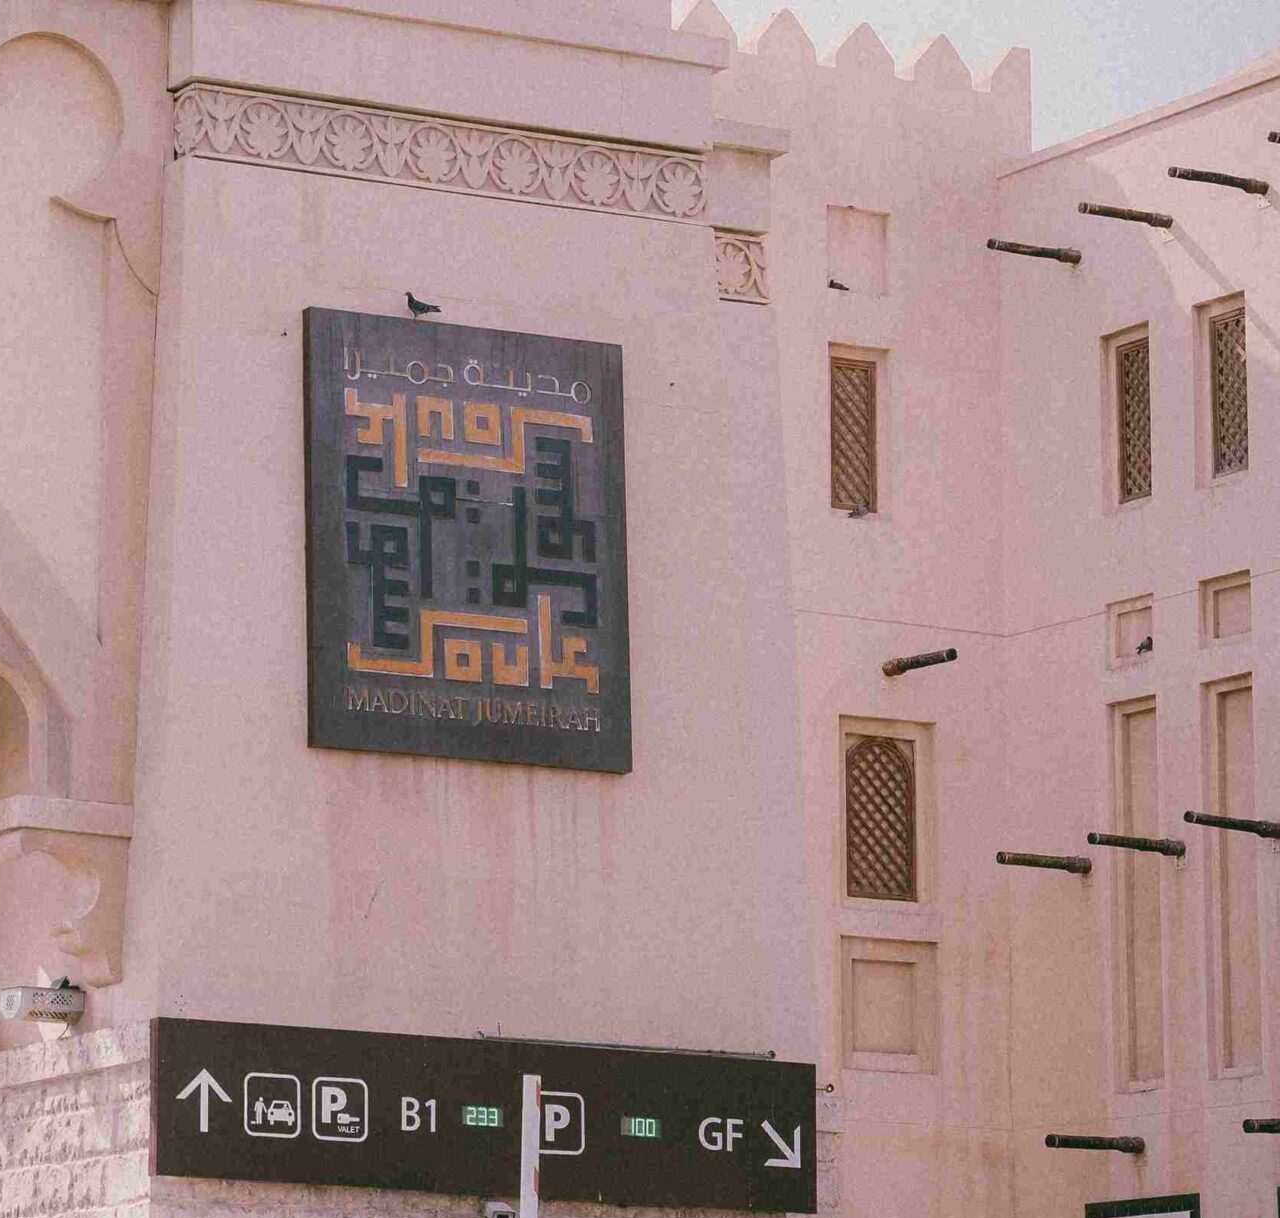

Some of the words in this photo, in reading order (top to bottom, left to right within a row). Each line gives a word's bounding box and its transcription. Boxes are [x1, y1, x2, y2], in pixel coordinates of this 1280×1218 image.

[345, 684, 464, 720] MADINAT
[472, 696, 601, 733] JUMEIRAH
[321, 1086, 347, 1124] P
[401, 1096, 437, 1133] B1
[466, 1106, 498, 1127] 233
[544, 1103, 570, 1142] P
[337, 1125, 360, 1134] VALET
[631, 1117, 656, 1137] 100
[698, 1116, 744, 1152] GF
